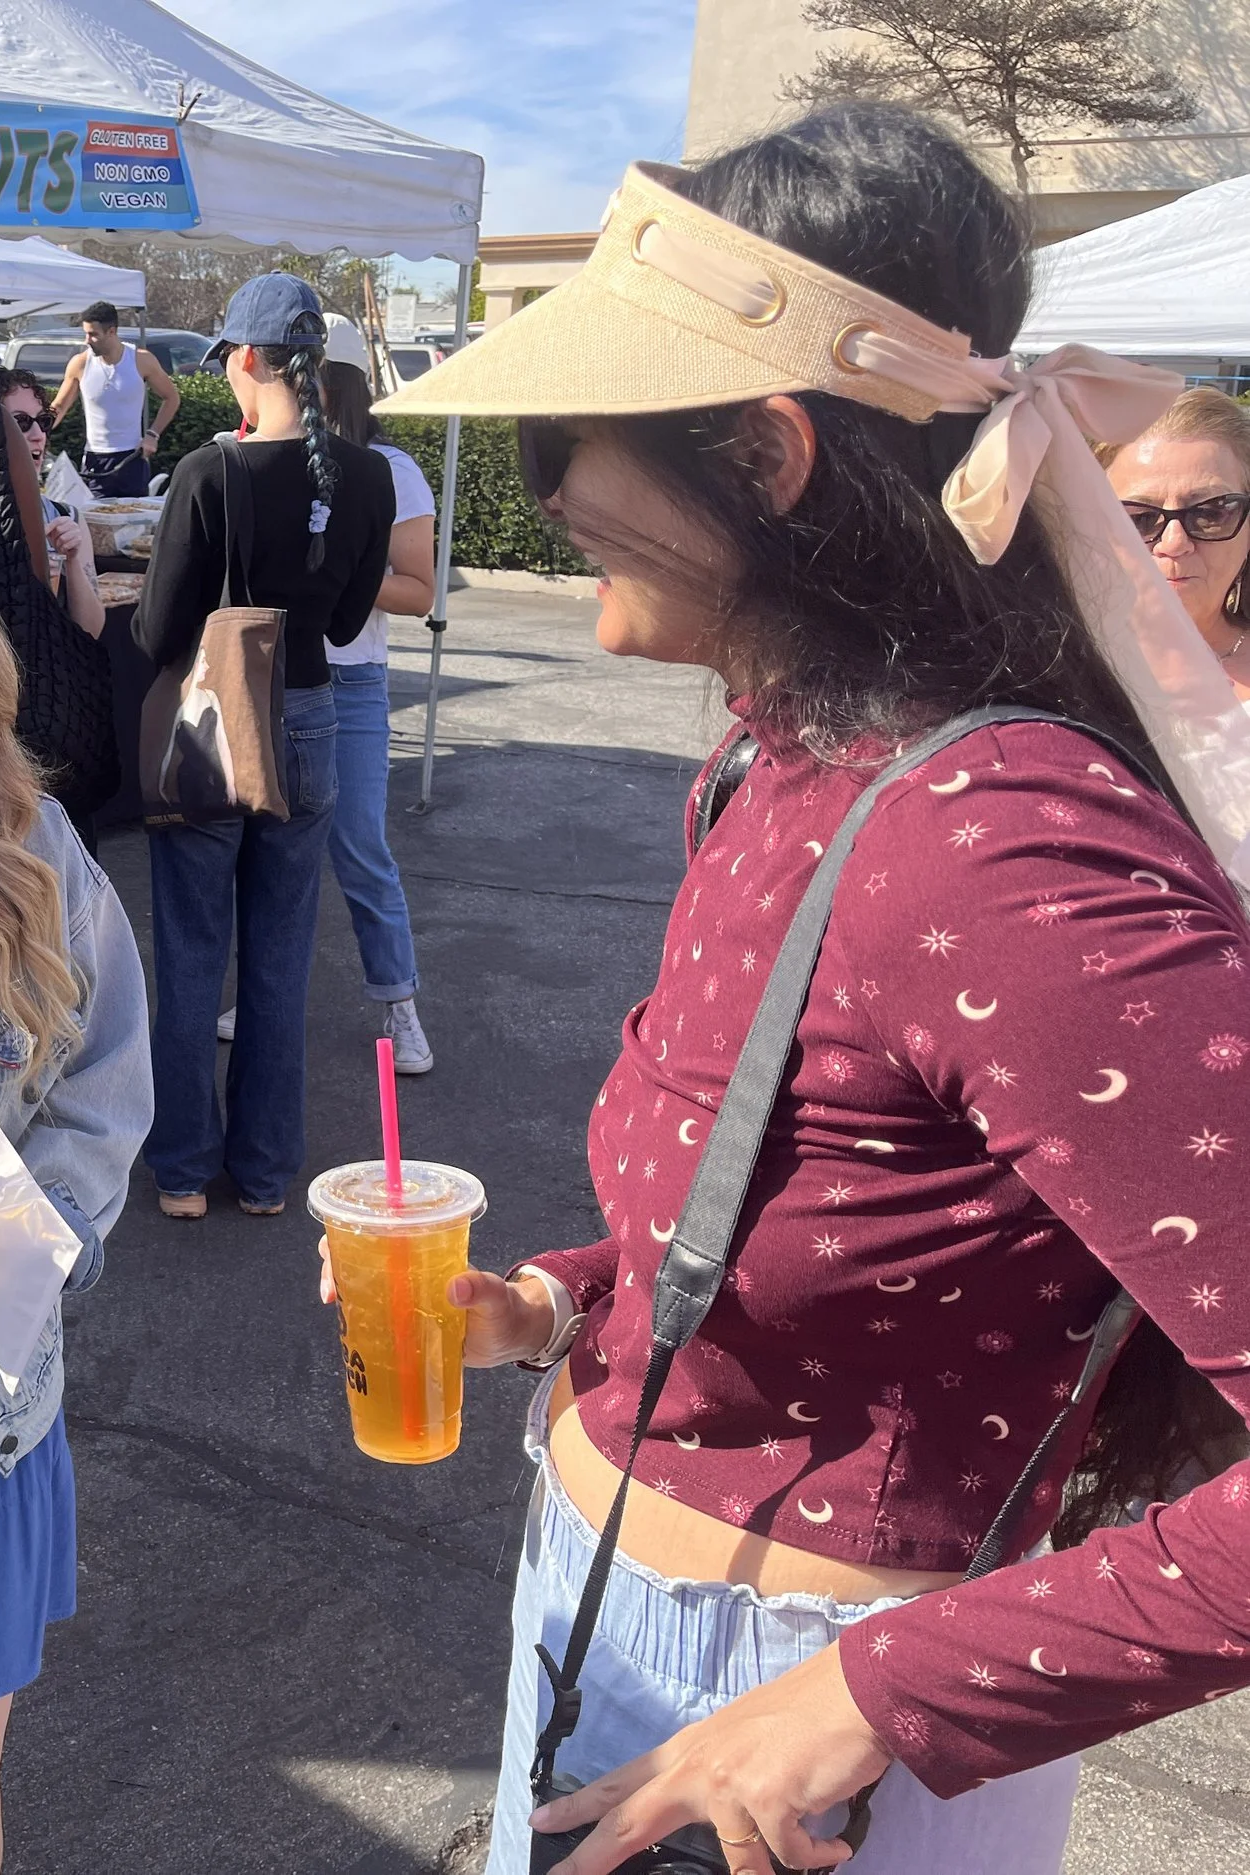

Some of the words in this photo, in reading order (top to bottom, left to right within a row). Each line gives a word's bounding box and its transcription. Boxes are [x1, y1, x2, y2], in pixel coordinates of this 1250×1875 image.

[90, 129, 133, 148] GLUTEN
[136, 132, 168, 151] FREE
[94, 162, 128, 182] NON
[132, 165, 170, 183] GMO
[100, 191, 168, 209] VEGAN
